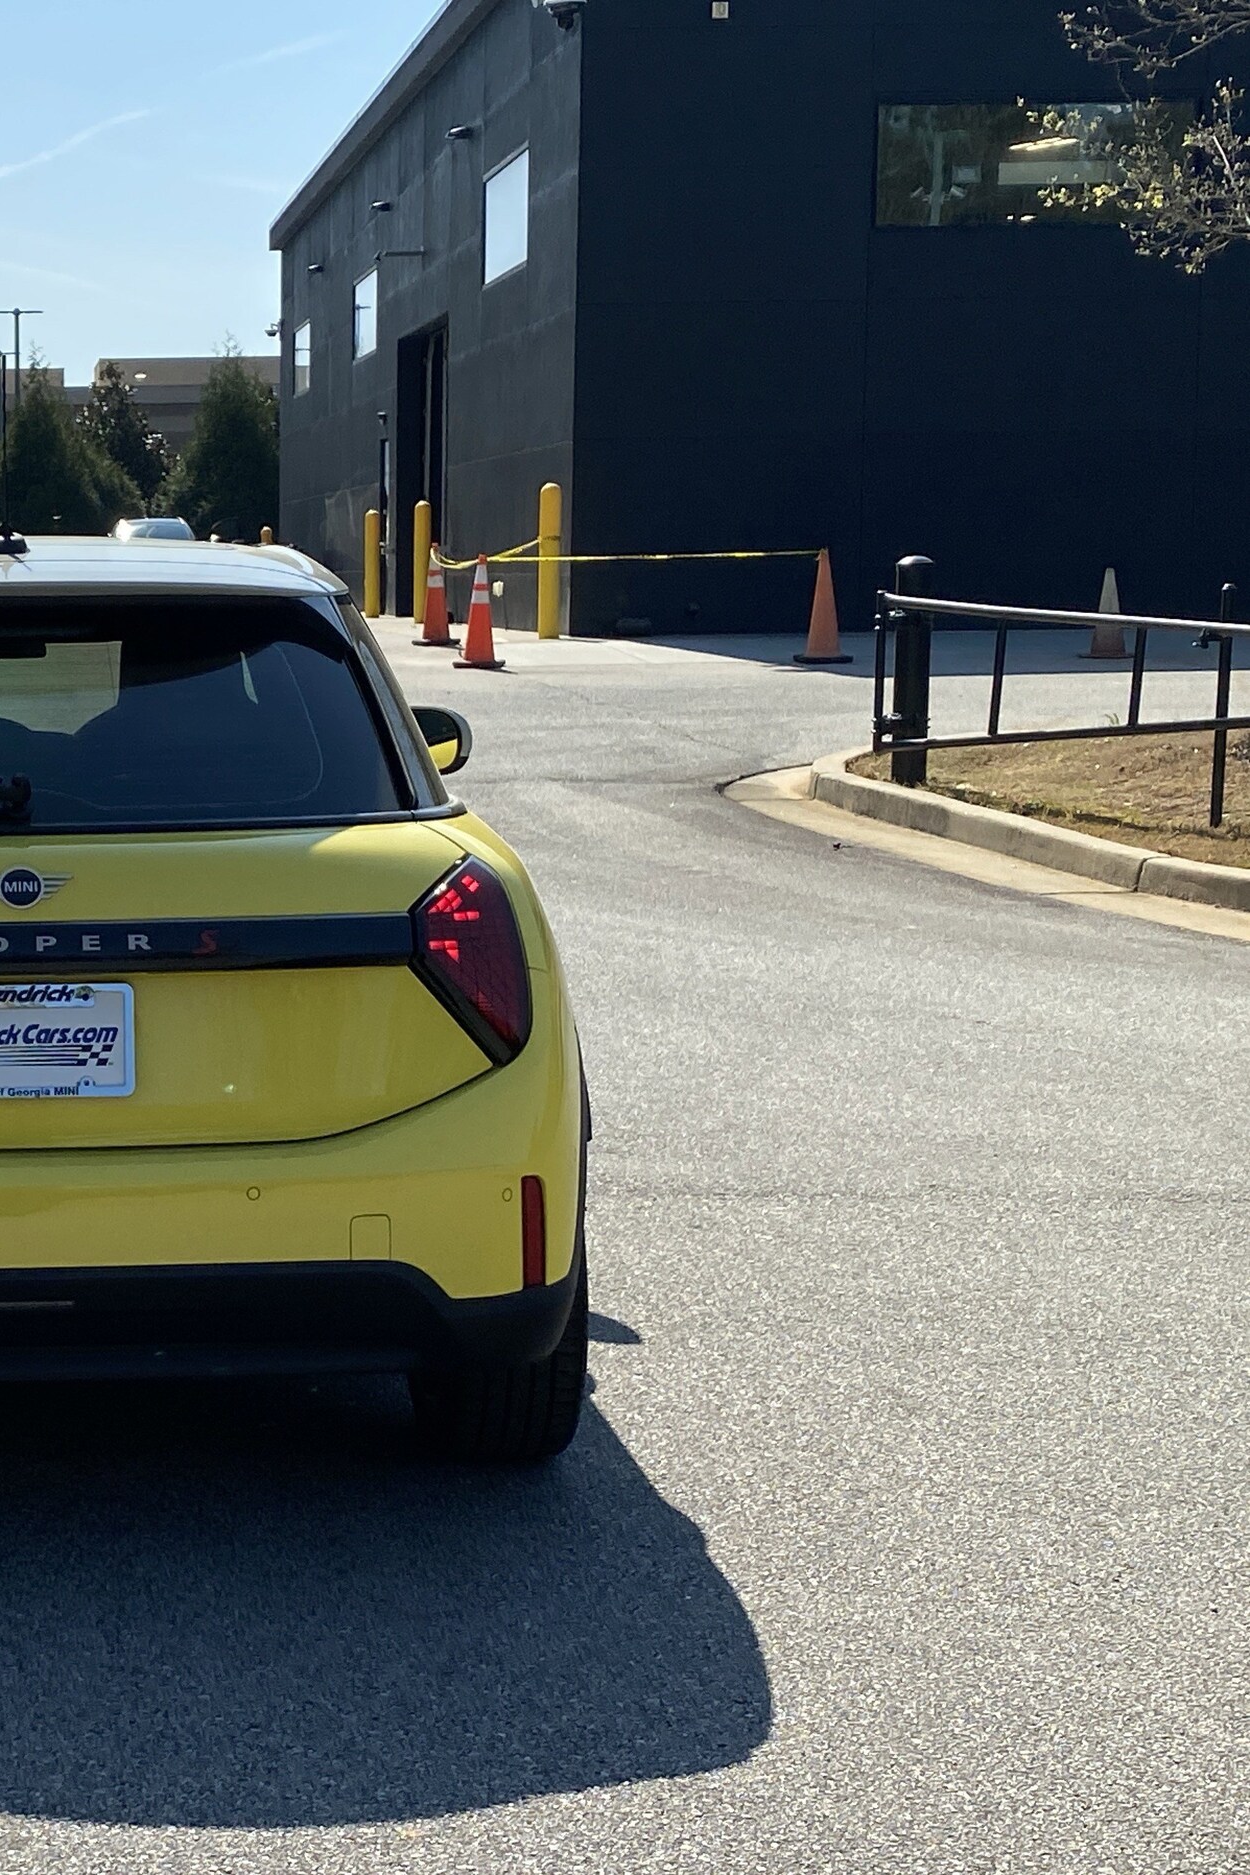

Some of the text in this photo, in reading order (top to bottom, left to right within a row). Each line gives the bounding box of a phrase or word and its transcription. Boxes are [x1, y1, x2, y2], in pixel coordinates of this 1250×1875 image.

[3, 880, 40, 894] MINI
[192, 929, 221, 954] S
[7, 1087, 51, 1099] Georgia
[53, 1086, 80, 1096] MINI
